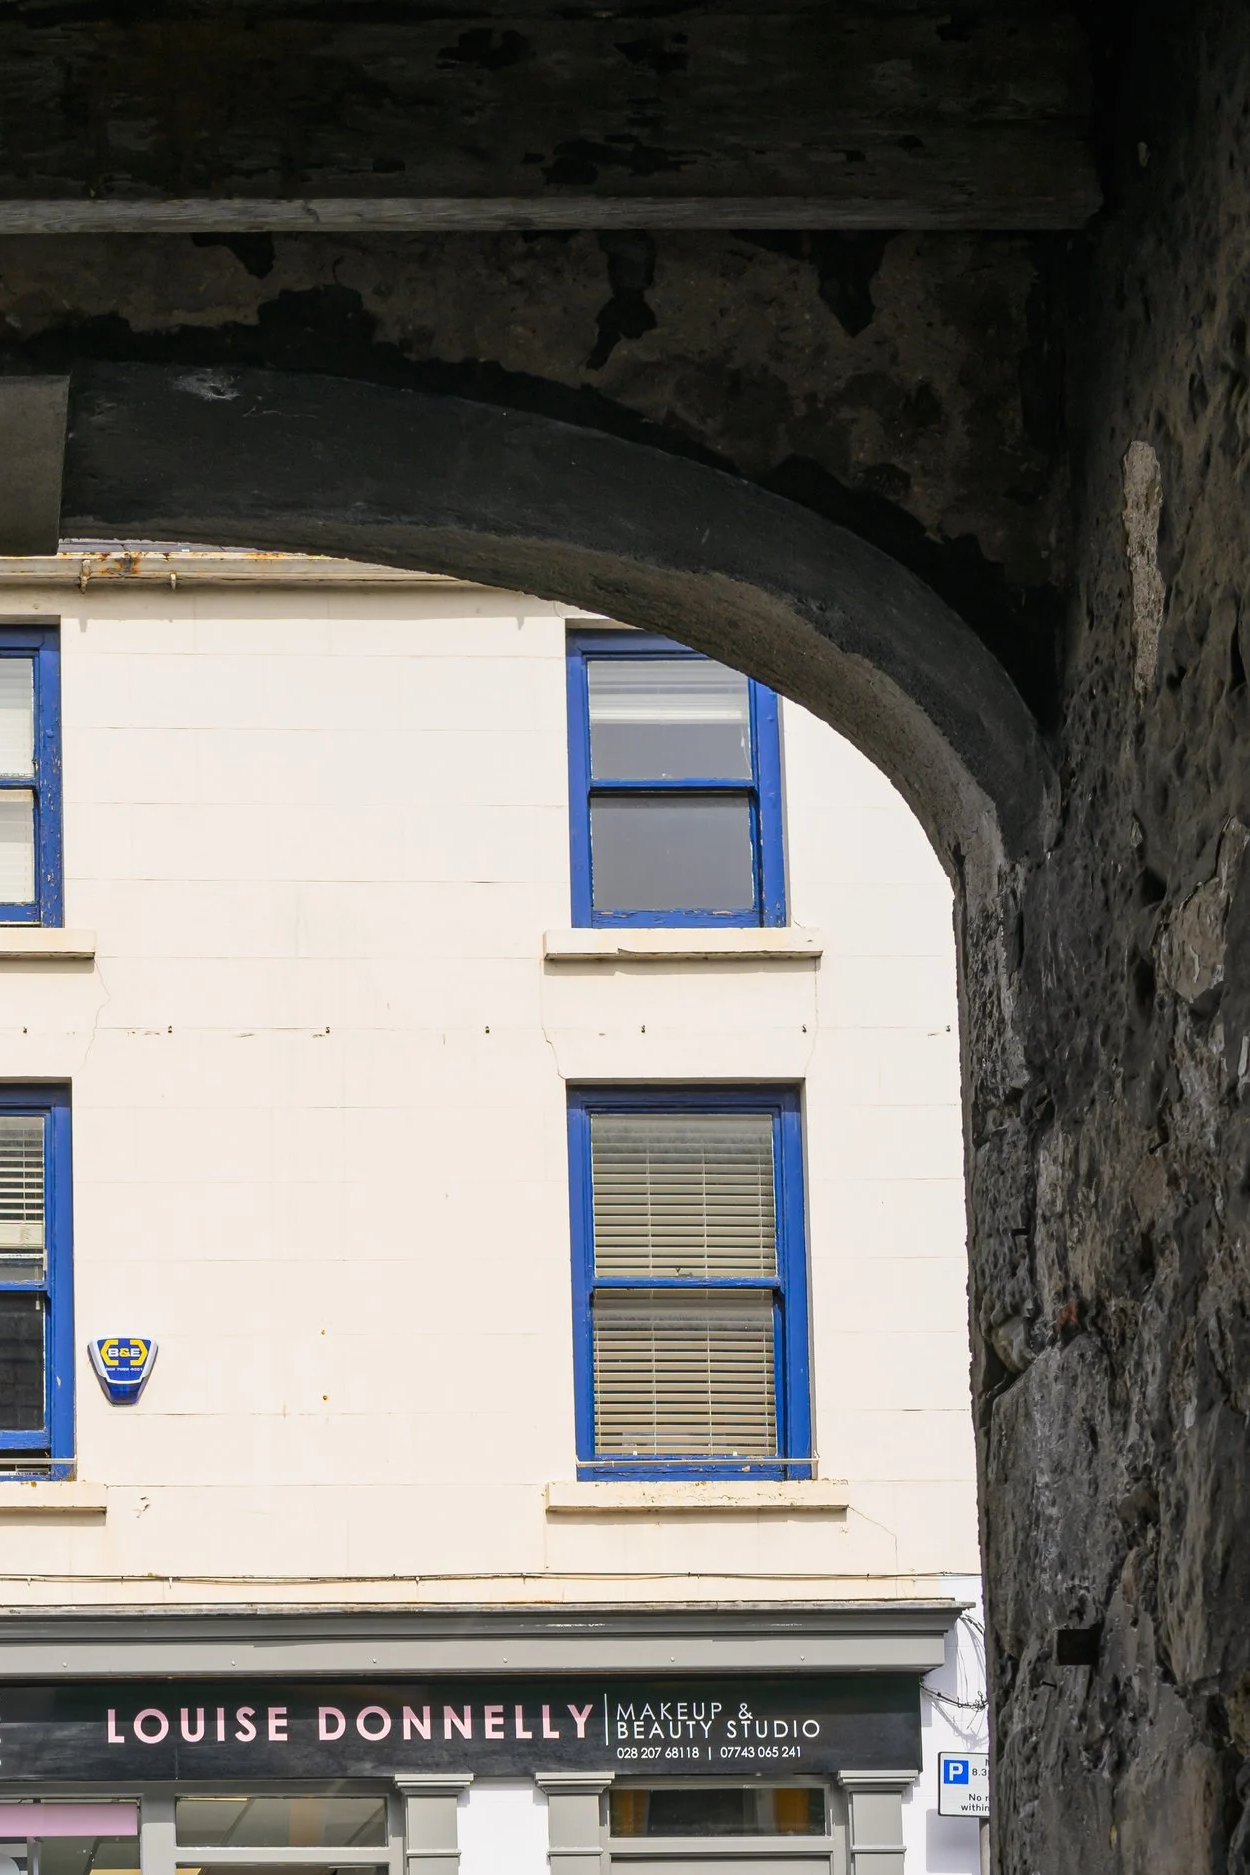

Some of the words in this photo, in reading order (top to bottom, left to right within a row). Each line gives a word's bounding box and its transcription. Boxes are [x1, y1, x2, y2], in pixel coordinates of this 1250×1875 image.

[108, 1347, 140, 1357] B&E
[616, 1702, 722, 1720] MAKEUP
[738, 1702, 754, 1720] &
[107, 1706, 288, 1745] LOUISE
[318, 1704, 593, 1742] DONNELLY
[617, 1720, 712, 1739] BEAUTY
[727, 1719, 820, 1738] STUDIO
[616, 1748, 638, 1759] 028
[640, 1747, 661, 1759] 207
[665, 1747, 699, 1759] 68118
[720, 1746, 755, 1758] 07743
[758, 1746, 779, 1758] 065
[781, 1746, 801, 1758] 241
[949, 1762, 963, 1781] P
[968, 1793, 982, 1802] No
